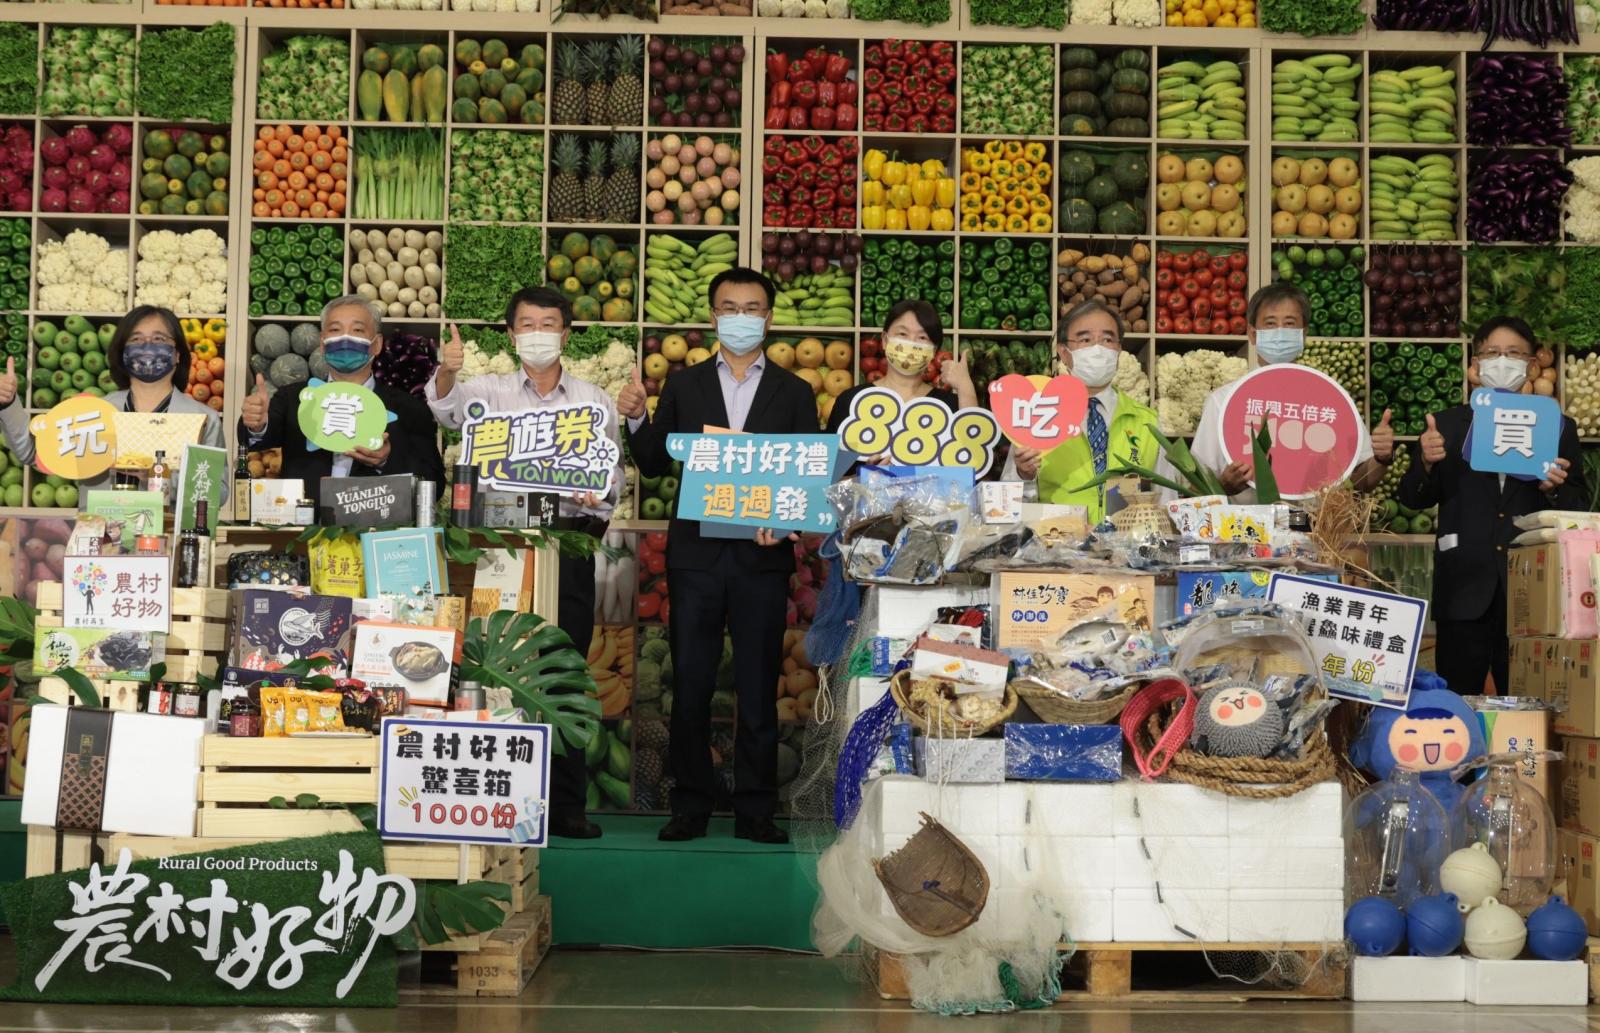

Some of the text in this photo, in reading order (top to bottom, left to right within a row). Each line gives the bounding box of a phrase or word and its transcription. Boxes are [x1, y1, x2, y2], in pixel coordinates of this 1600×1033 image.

[1246, 398, 1337, 424] 振興五倍券
[472, 406, 597, 480] 農遊券
[842, 391, 998, 474] 888
[335, 485, 388, 505] YUANLIN
[344, 494, 395, 514] TONGLUO
[384, 550, 419, 562] JASMINE
[111, 572, 162, 594] 農村
[111, 597, 162, 619] 好物
[1301, 591, 1389, 624] 漁業青年
[1321, 652, 1376, 684] 年份
[396, 730, 534, 764] 農村好物
[421, 766, 512, 797] 驚喜箱
[412, 802, 517, 829] 1000份
[158, 856, 318, 871] Rural Good Products
[34, 847, 416, 999] 農村好物
